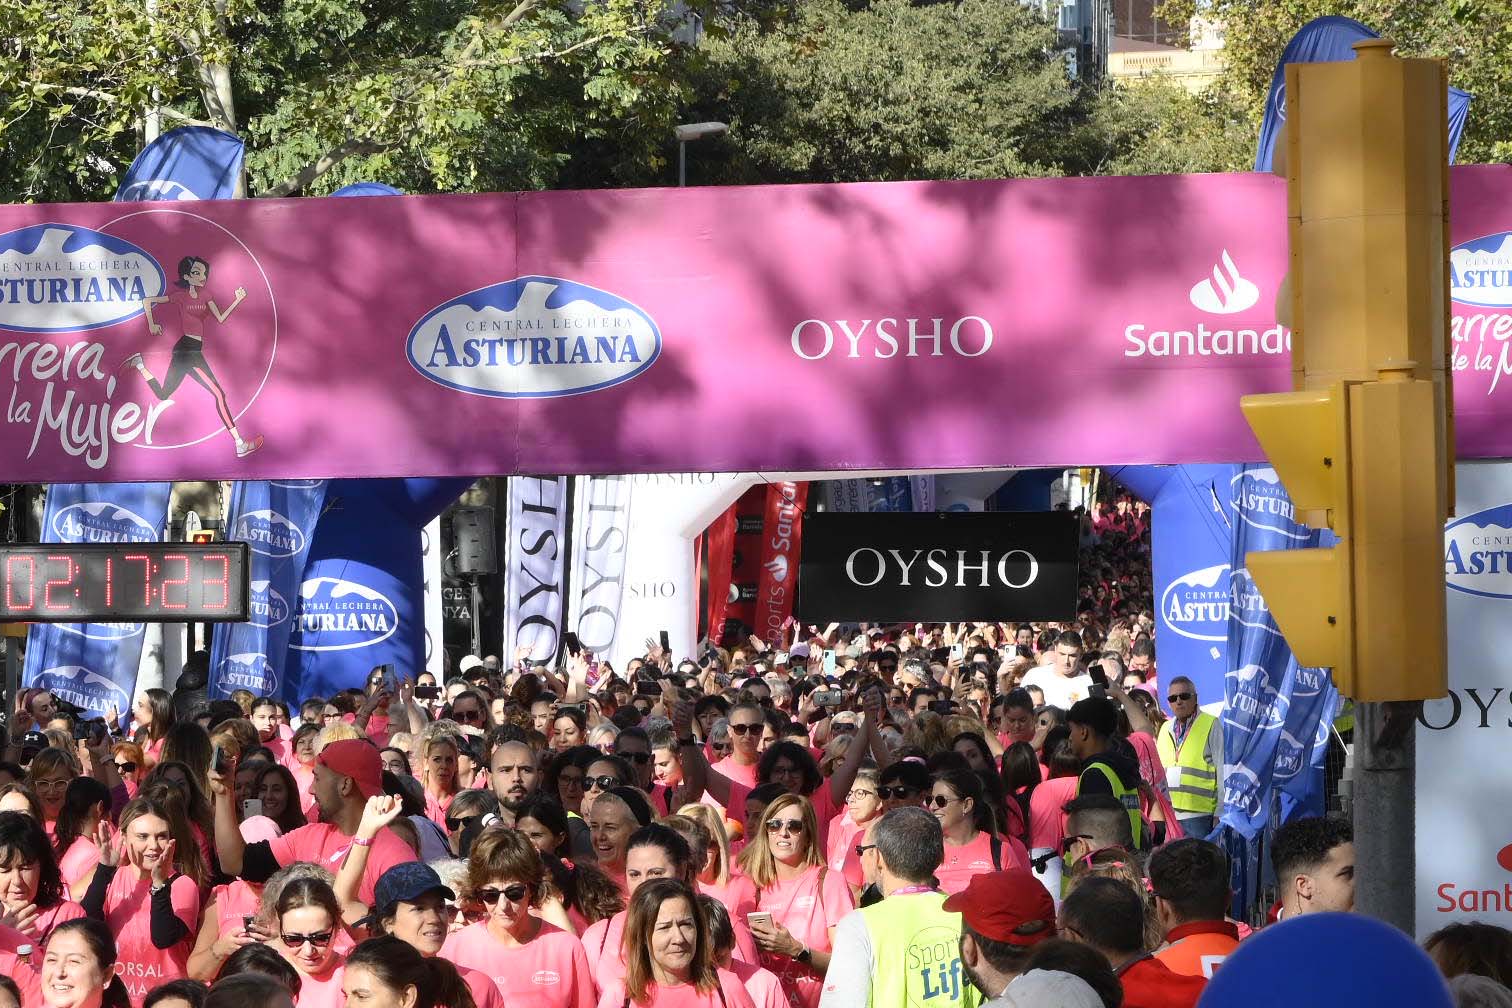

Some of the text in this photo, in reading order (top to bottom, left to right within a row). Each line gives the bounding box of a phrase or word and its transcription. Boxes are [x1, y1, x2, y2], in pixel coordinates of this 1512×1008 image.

[69, 259, 141, 272] LECHERA
[1450, 261, 1512, 289] ASTU
[466, 318, 633, 332] CENTRAL LECHERA
[791, 315, 995, 361] OYSHO
[426, 324, 642, 368] ASTURIANA
[1474, 340, 1493, 371] la
[7, 384, 32, 424] la
[26, 375, 176, 470] Mujer
[771, 482, 797, 551] Santa
[5, 555, 230, 610] 02:17:23
[845, 547, 1039, 589] OYSHO
[630, 581, 676, 598] SHO
[335, 601, 384, 611] LECHERA
[113, 961, 164, 977] ORSAL
[126, 980, 148, 994] MA
